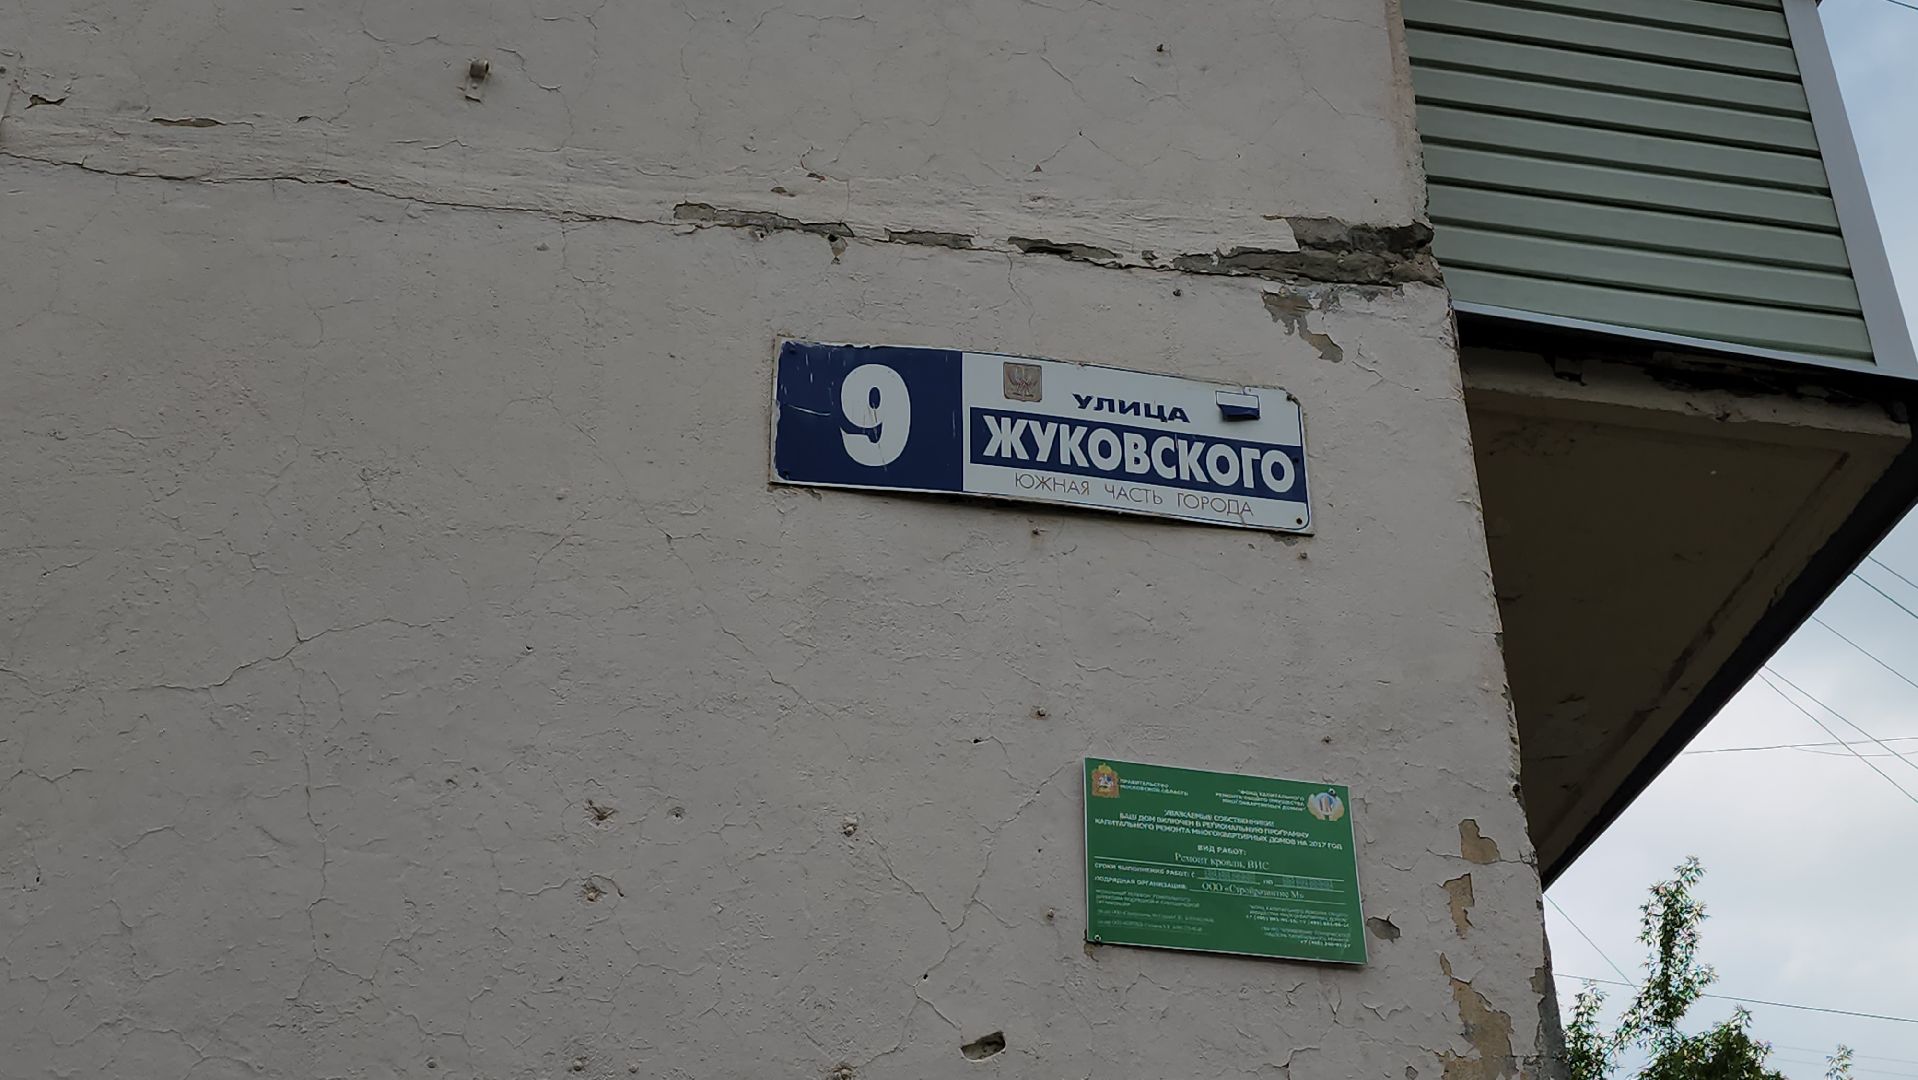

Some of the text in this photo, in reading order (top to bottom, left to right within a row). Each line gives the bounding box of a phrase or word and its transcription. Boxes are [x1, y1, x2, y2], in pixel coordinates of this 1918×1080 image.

[840, 363, 911, 467] 9
[1072, 393, 1191, 424] УЛИЦА
[982, 415, 1296, 494] ЖУКОВСКОГО
[1015, 472, 1254, 517] ЮЖНАЯ ЧАСТЬ ГОРОДА
[1119, 812, 1137, 821] ВАШ
[1138, 814, 1156, 823] ДОМ
[1094, 818, 1155, 831] КАПИТАЛЬНОГО
[1155, 824, 1191, 834] РЕМОНТА
[1268, 837, 1297, 846] ДОМОВ
[1309, 841, 1327, 849] 2017
[1327, 843, 1343, 851] ГОД
[1174, 852, 1208, 865] Ремонт
[1197, 844, 1247, 857] ВИД РАБОТ:
[1201, 881, 1223, 892] ООО
